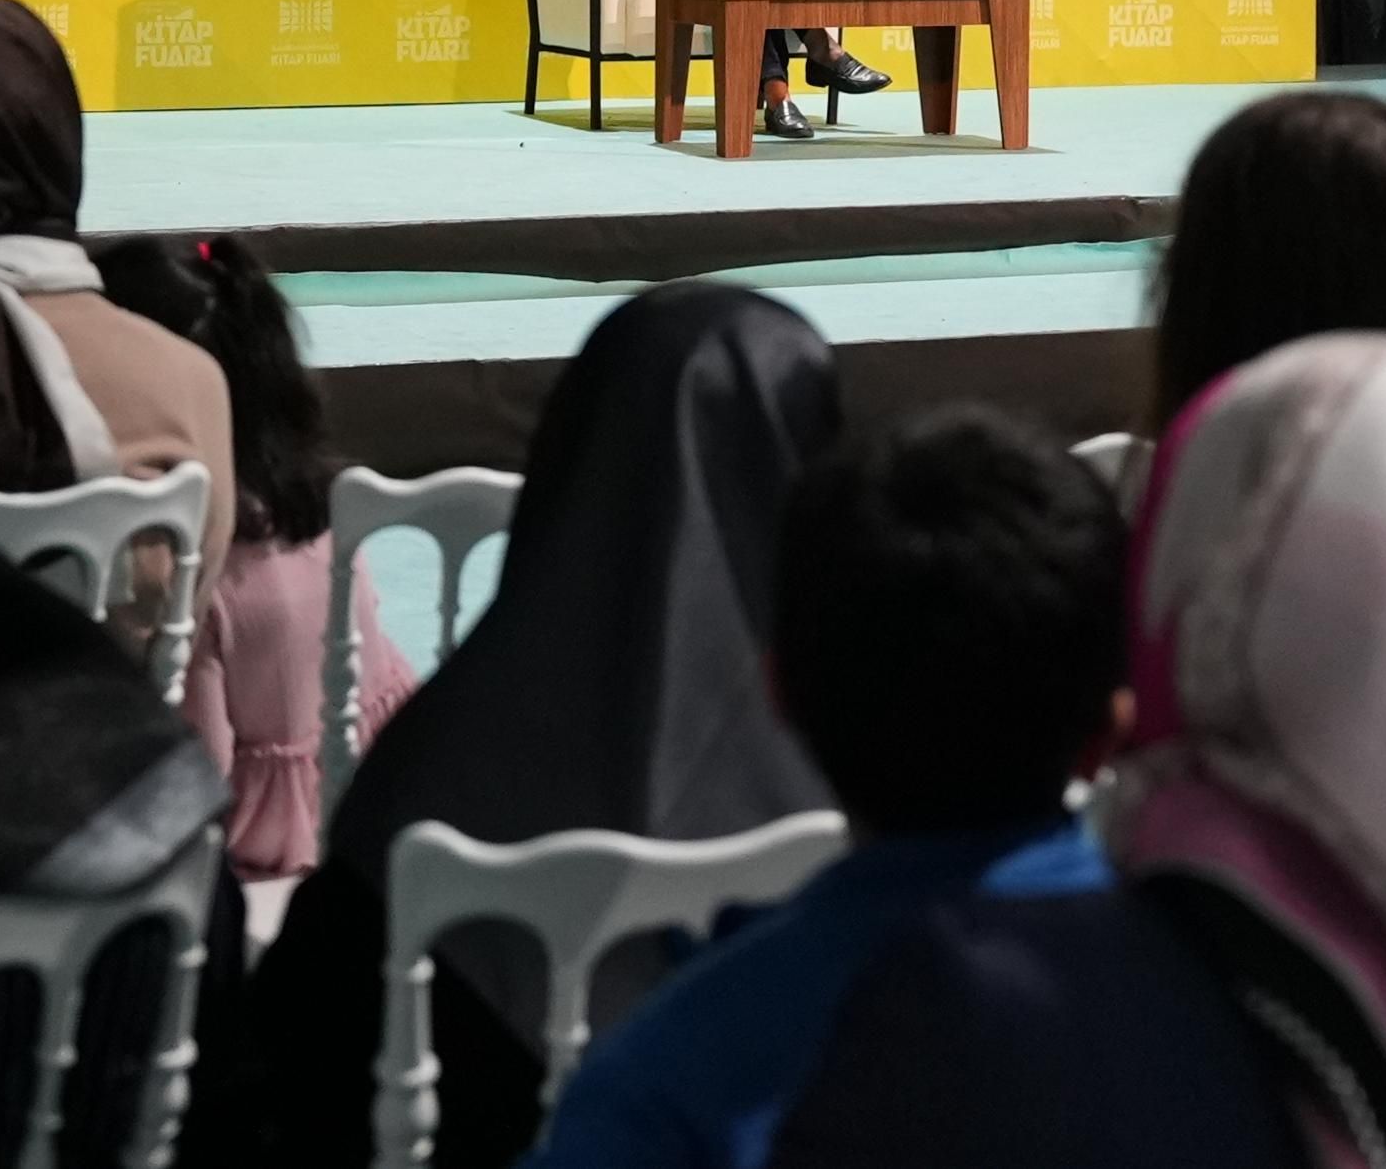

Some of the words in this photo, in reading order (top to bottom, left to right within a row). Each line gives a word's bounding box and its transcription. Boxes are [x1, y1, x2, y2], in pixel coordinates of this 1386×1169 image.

[1108, 27, 1173, 47] FUARI
[136, 45, 212, 67] FUARI
[397, 41, 469, 62] FUARI
